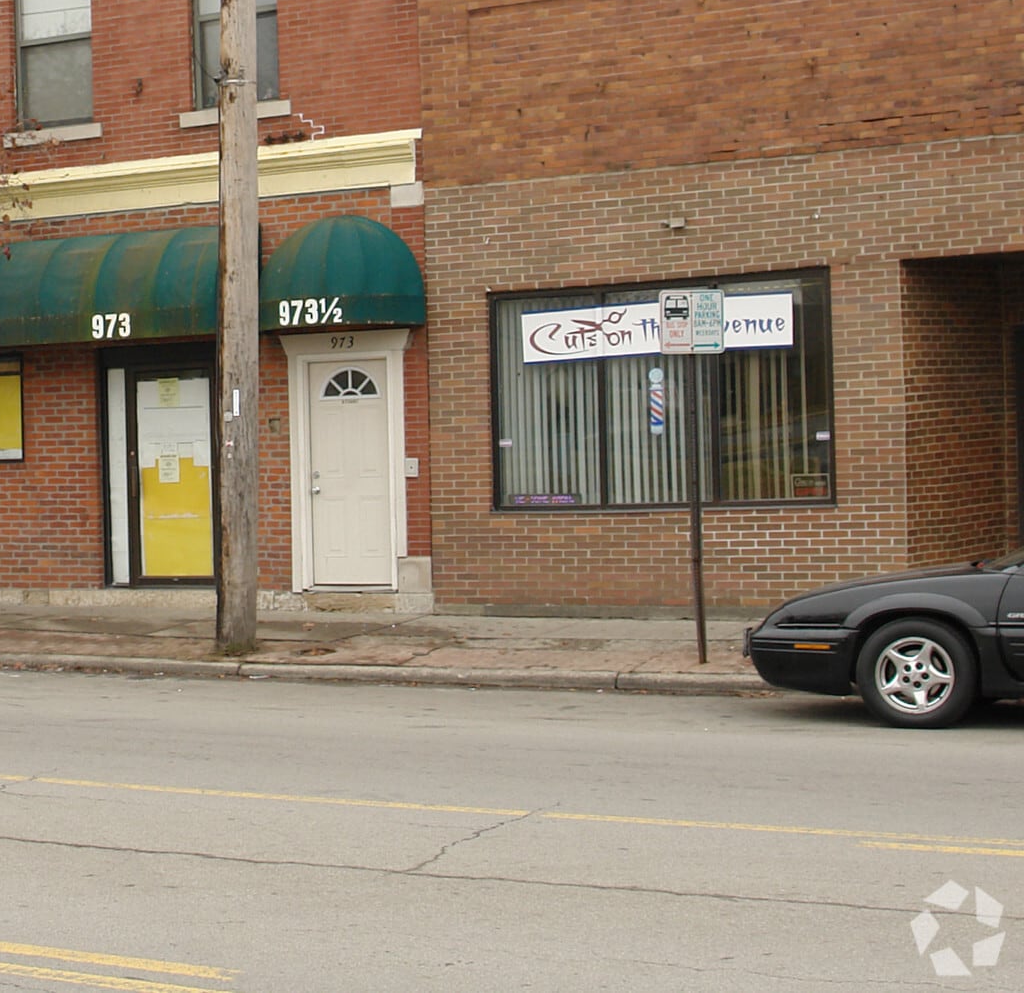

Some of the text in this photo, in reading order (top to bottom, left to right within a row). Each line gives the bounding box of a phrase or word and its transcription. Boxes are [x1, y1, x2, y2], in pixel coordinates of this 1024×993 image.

[696, 303, 717, 311] HOUR
[694, 311, 721, 319] PARKING
[91, 313, 131, 339] 973
[603, 330, 632, 346] on
[632, 318, 661, 342] th
[724, 317, 785, 335] venue
[669, 330, 684, 338] ONLY
[331, 336, 354, 349] 973
